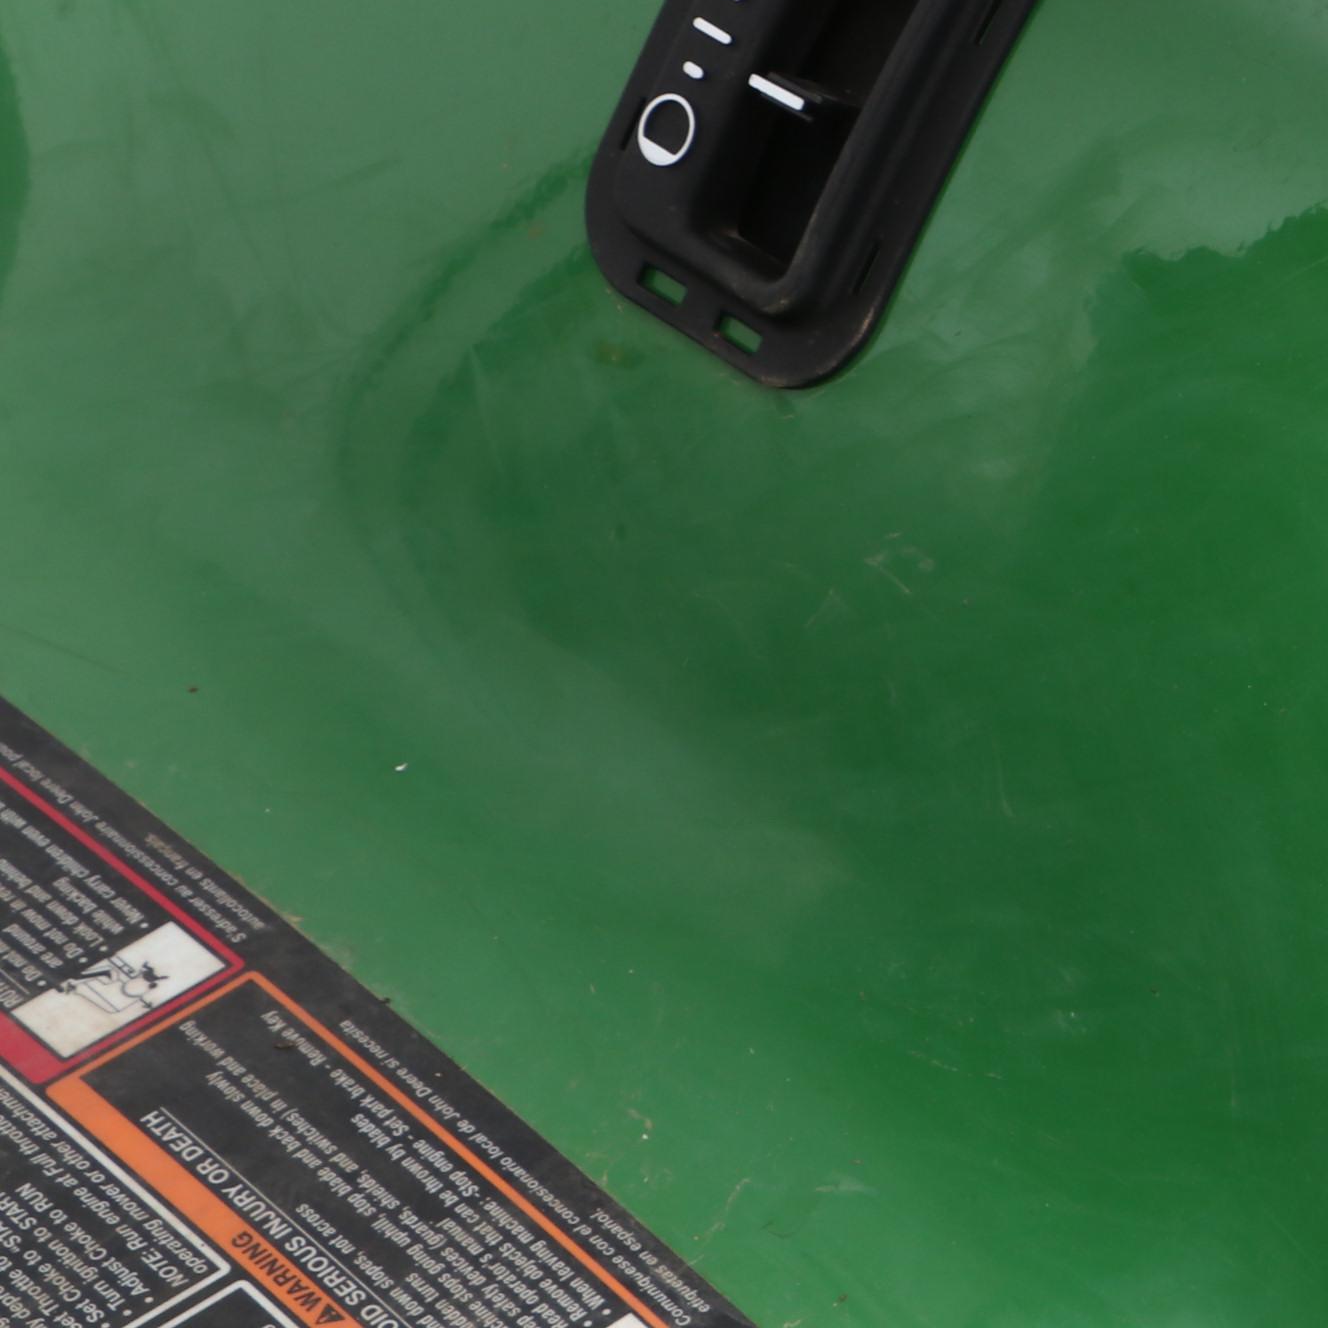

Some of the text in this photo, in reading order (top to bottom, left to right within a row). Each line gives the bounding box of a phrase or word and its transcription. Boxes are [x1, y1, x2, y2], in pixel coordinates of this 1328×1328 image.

[260, 1010, 287, 1032] Key
[178, 1020, 225, 1059] working
[281, 1027, 327, 1067] Remove
[339, 1019, 390, 1059] necesita
[216, 1055, 247, 1076] and
[205, 1070, 246, 1103] slowly
[240, 1073, 279, 1101] place
[329, 1068, 366, 1099] brake
[395, 1067, 433, 1098] Deere
[240, 1099, 275, 1128] down
[269, 1098, 288, 1114] in
[359, 1094, 395, 1119] park
[428, 1094, 461, 1120] John
[140, 1110, 204, 1162] DEATH
[268, 1125, 302, 1153] back
[383, 1115, 410, 1137] Set
[456, 1119, 476, 1134] de
[51, 1141, 91, 1170] other
[291, 1148, 323, 1169] and
[412, 1139, 454, 1173] engine
[468, 1132, 505, 1159] local
[29, 1152, 65, 1177] Full
[83, 1170, 106, 1184] or
[195, 1158, 230, 1184] OR
[328, 1152, 359, 1173] and
[55, 1173, 79, 1188] at
[317, 1166, 353, 1197] blade
[499, 1156, 581, 1225] concesionario
[73, 1186, 121, 1225] engine
[100, 1183, 150, 1221] mower
[221, 1183, 293, 1240] INJURY
[346, 1193, 377, 1217] stop
[350, 1113, 588, 1322] Remove objects that can be thrown by blades
[295, 1203, 337, 1237] across
[371, 1213, 412, 1248] uphill,
[479, 1197, 535, 1244] machine:
[572, 1224, 593, 1236] el
[0, 1192, 126, 1311] Turn ignition to STAR
[15, 1182, 150, 1296] Adjust Choke to RUN
[115, 1224, 148, 1251] Run
[142, 1218, 208, 1274] operating
[328, 1234, 356, 1255] not
[435, 1217, 485, 1256] manual
[588, 1234, 615, 1256] con
[22, 1249, 42, 1266] to
[140, 1247, 189, 1288] NOTE:
[231, 1231, 323, 1311] WARNING
[284, 1236, 367, 1306] SERIOUS
[353, 1251, 395, 1289] slopes,
[406, 1243, 446, 1275] going
[440, 1247, 487, 1286] devices
[529, 1240, 575, 1282] leaving
[638, 1250, 659, 1266] en
[8, 1268, 59, 1316] Throttle
[37, 1263, 82, 1303] Choke
[404, 1272, 440, 1303] turns
[437, 1272, 474, 1303] stops
[569, 1277, 606, 1310] When
[653, 1264, 711, 1313] etiquetas
[74, 1298, 105, 1323] Set
[389, 1287, 425, 1317] down
[481, 1283, 521, 1317] safety
